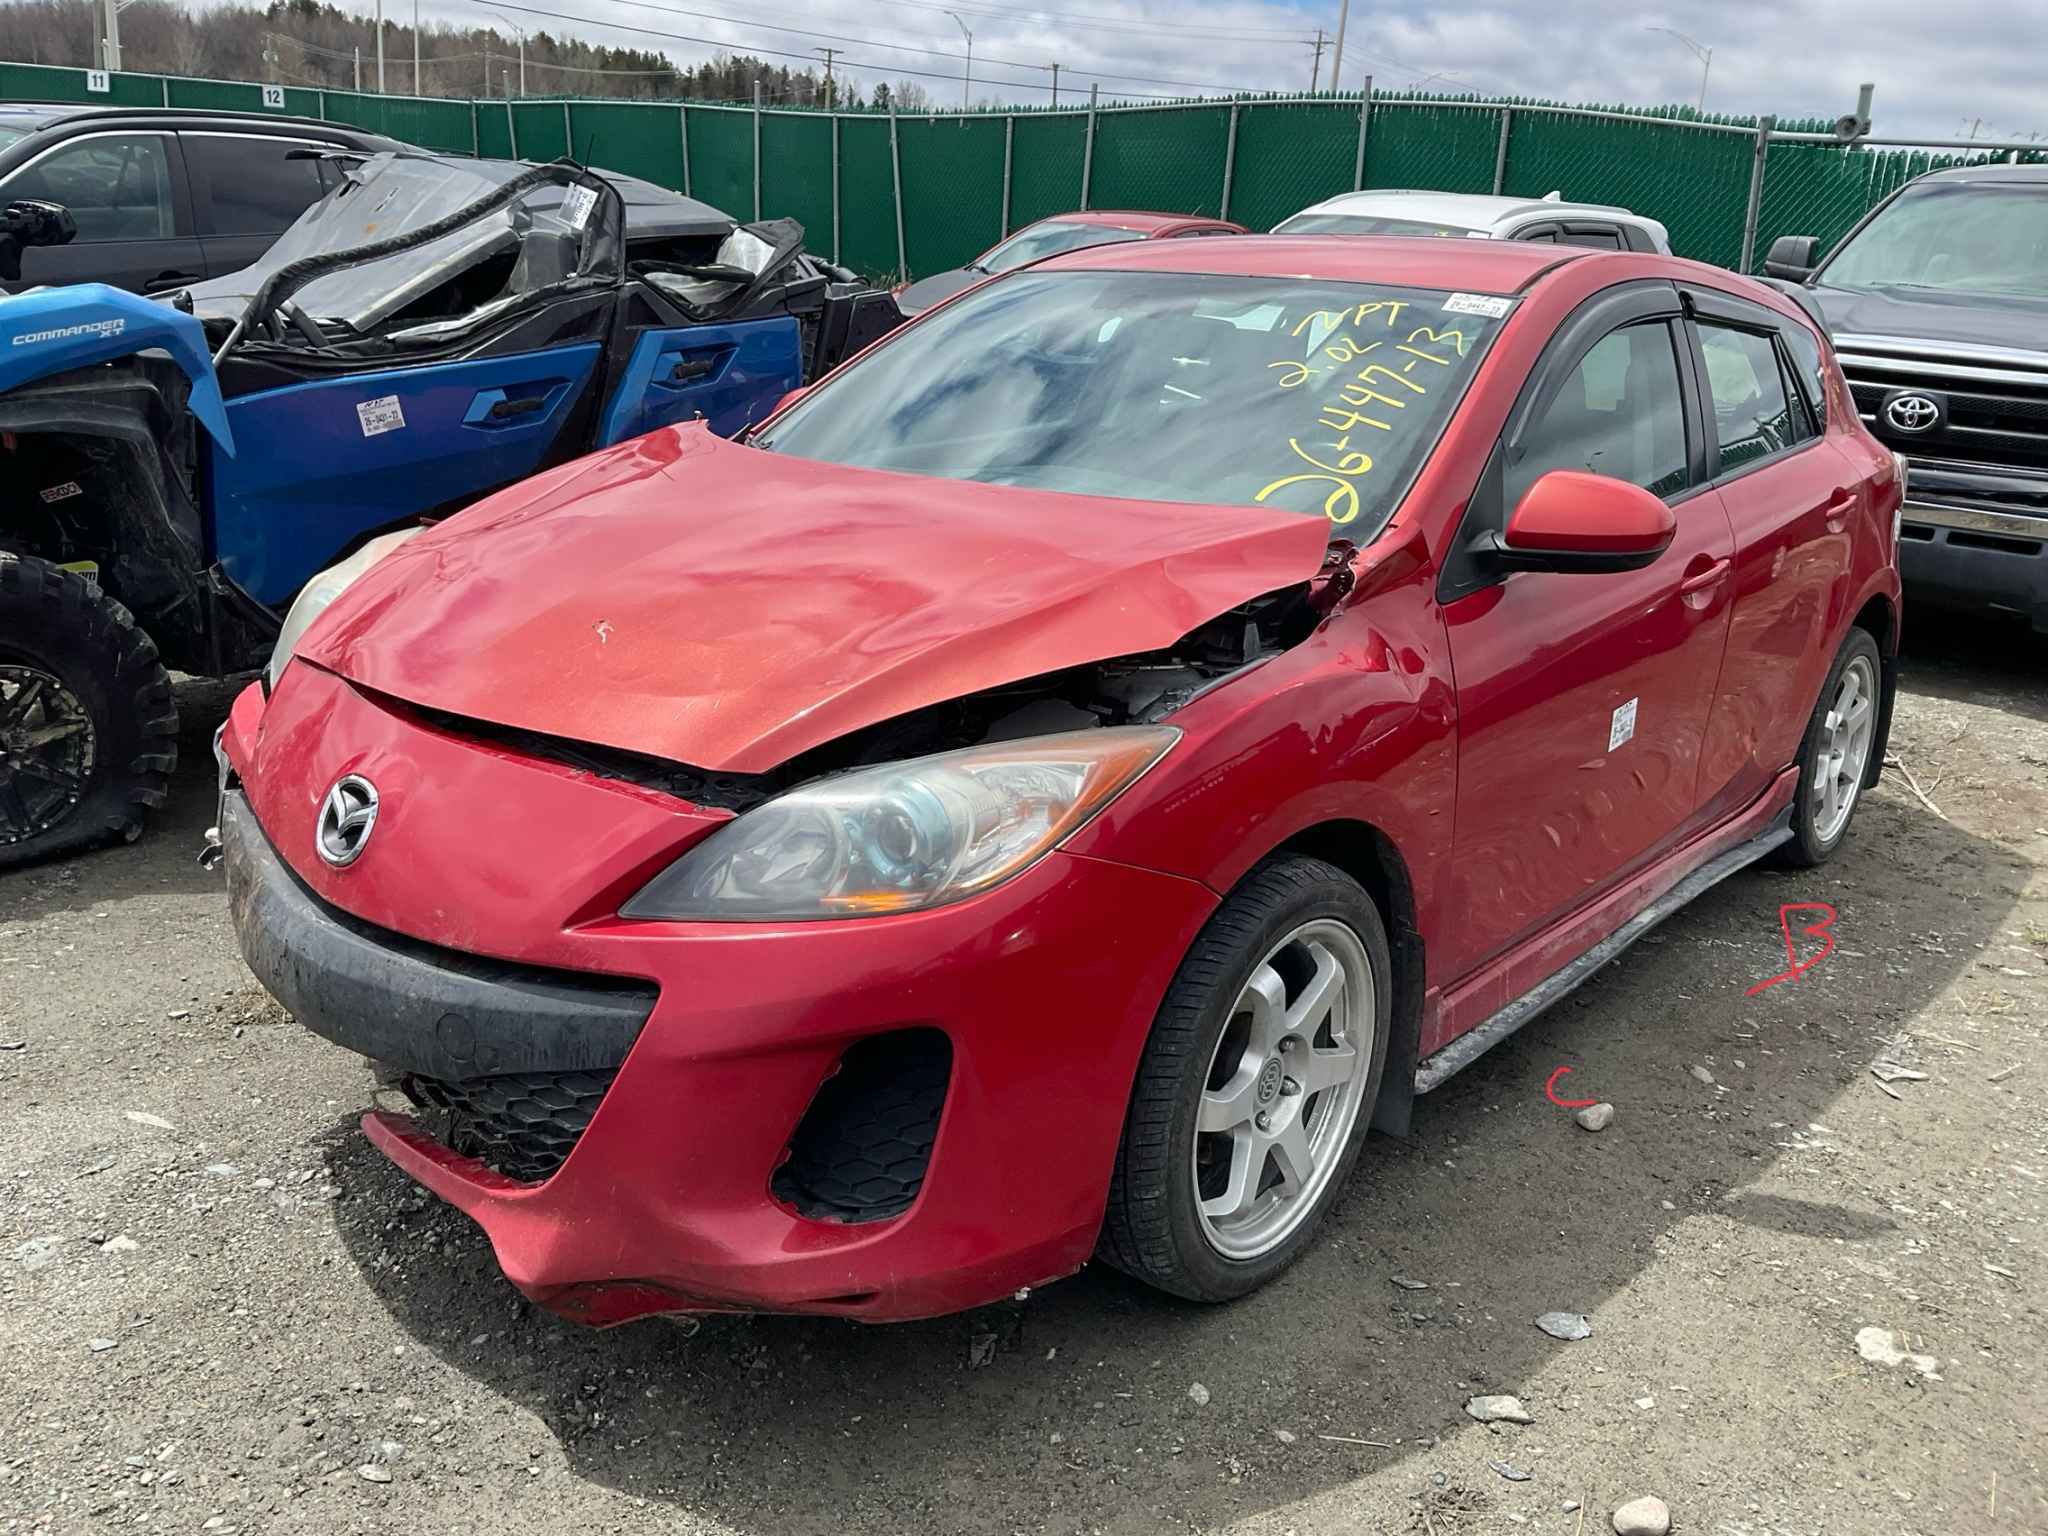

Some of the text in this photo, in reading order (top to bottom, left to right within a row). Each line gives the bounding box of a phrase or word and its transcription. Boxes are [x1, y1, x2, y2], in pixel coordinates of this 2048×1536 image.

[91, 74, 104, 88] 11
[265, 90, 281, 104] 12
[12, 318, 125, 345] COMMANDER
[99, 327, 125, 338] XT
